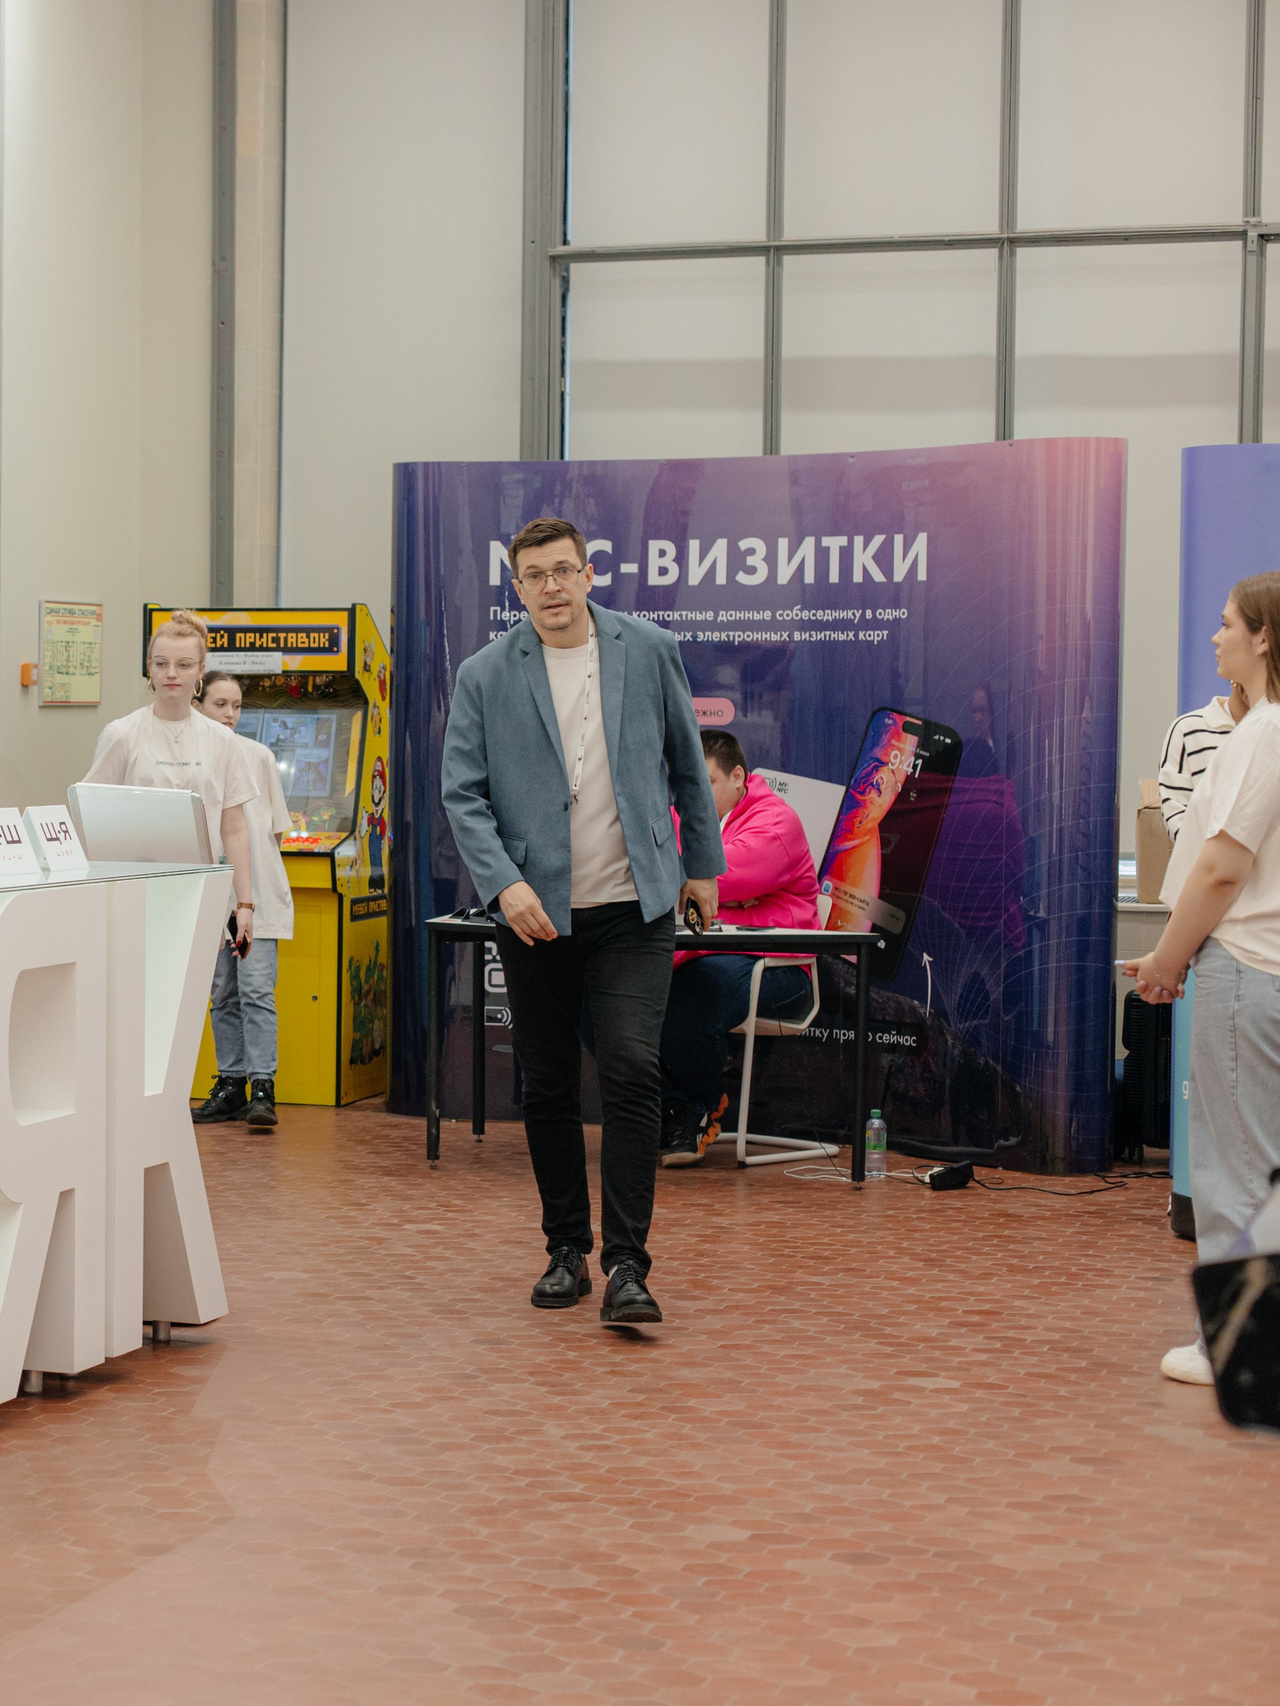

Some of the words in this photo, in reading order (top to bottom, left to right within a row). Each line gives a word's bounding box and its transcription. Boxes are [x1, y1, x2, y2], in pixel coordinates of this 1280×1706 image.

[489, 532, 928, 587] NC-ВИЗИТКИ
[632, 610, 714, 621] контактные
[718, 610, 772, 622] данные
[776, 605, 863, 624] собеседнику
[866, 609, 873, 619] в
[876, 608, 908, 621] одно
[236, 632, 329, 648] ПРИСТАВОК
[696, 631, 790, 645] электронных
[794, 631, 855, 641] визитных
[859, 630, 889, 645] карт
[694, 708, 724, 718] ежно
[888, 750, 923, 779] 9:41
[40, 821, 72, 845] Щ-Я
[876, 1031, 917, 1046] сейчас
